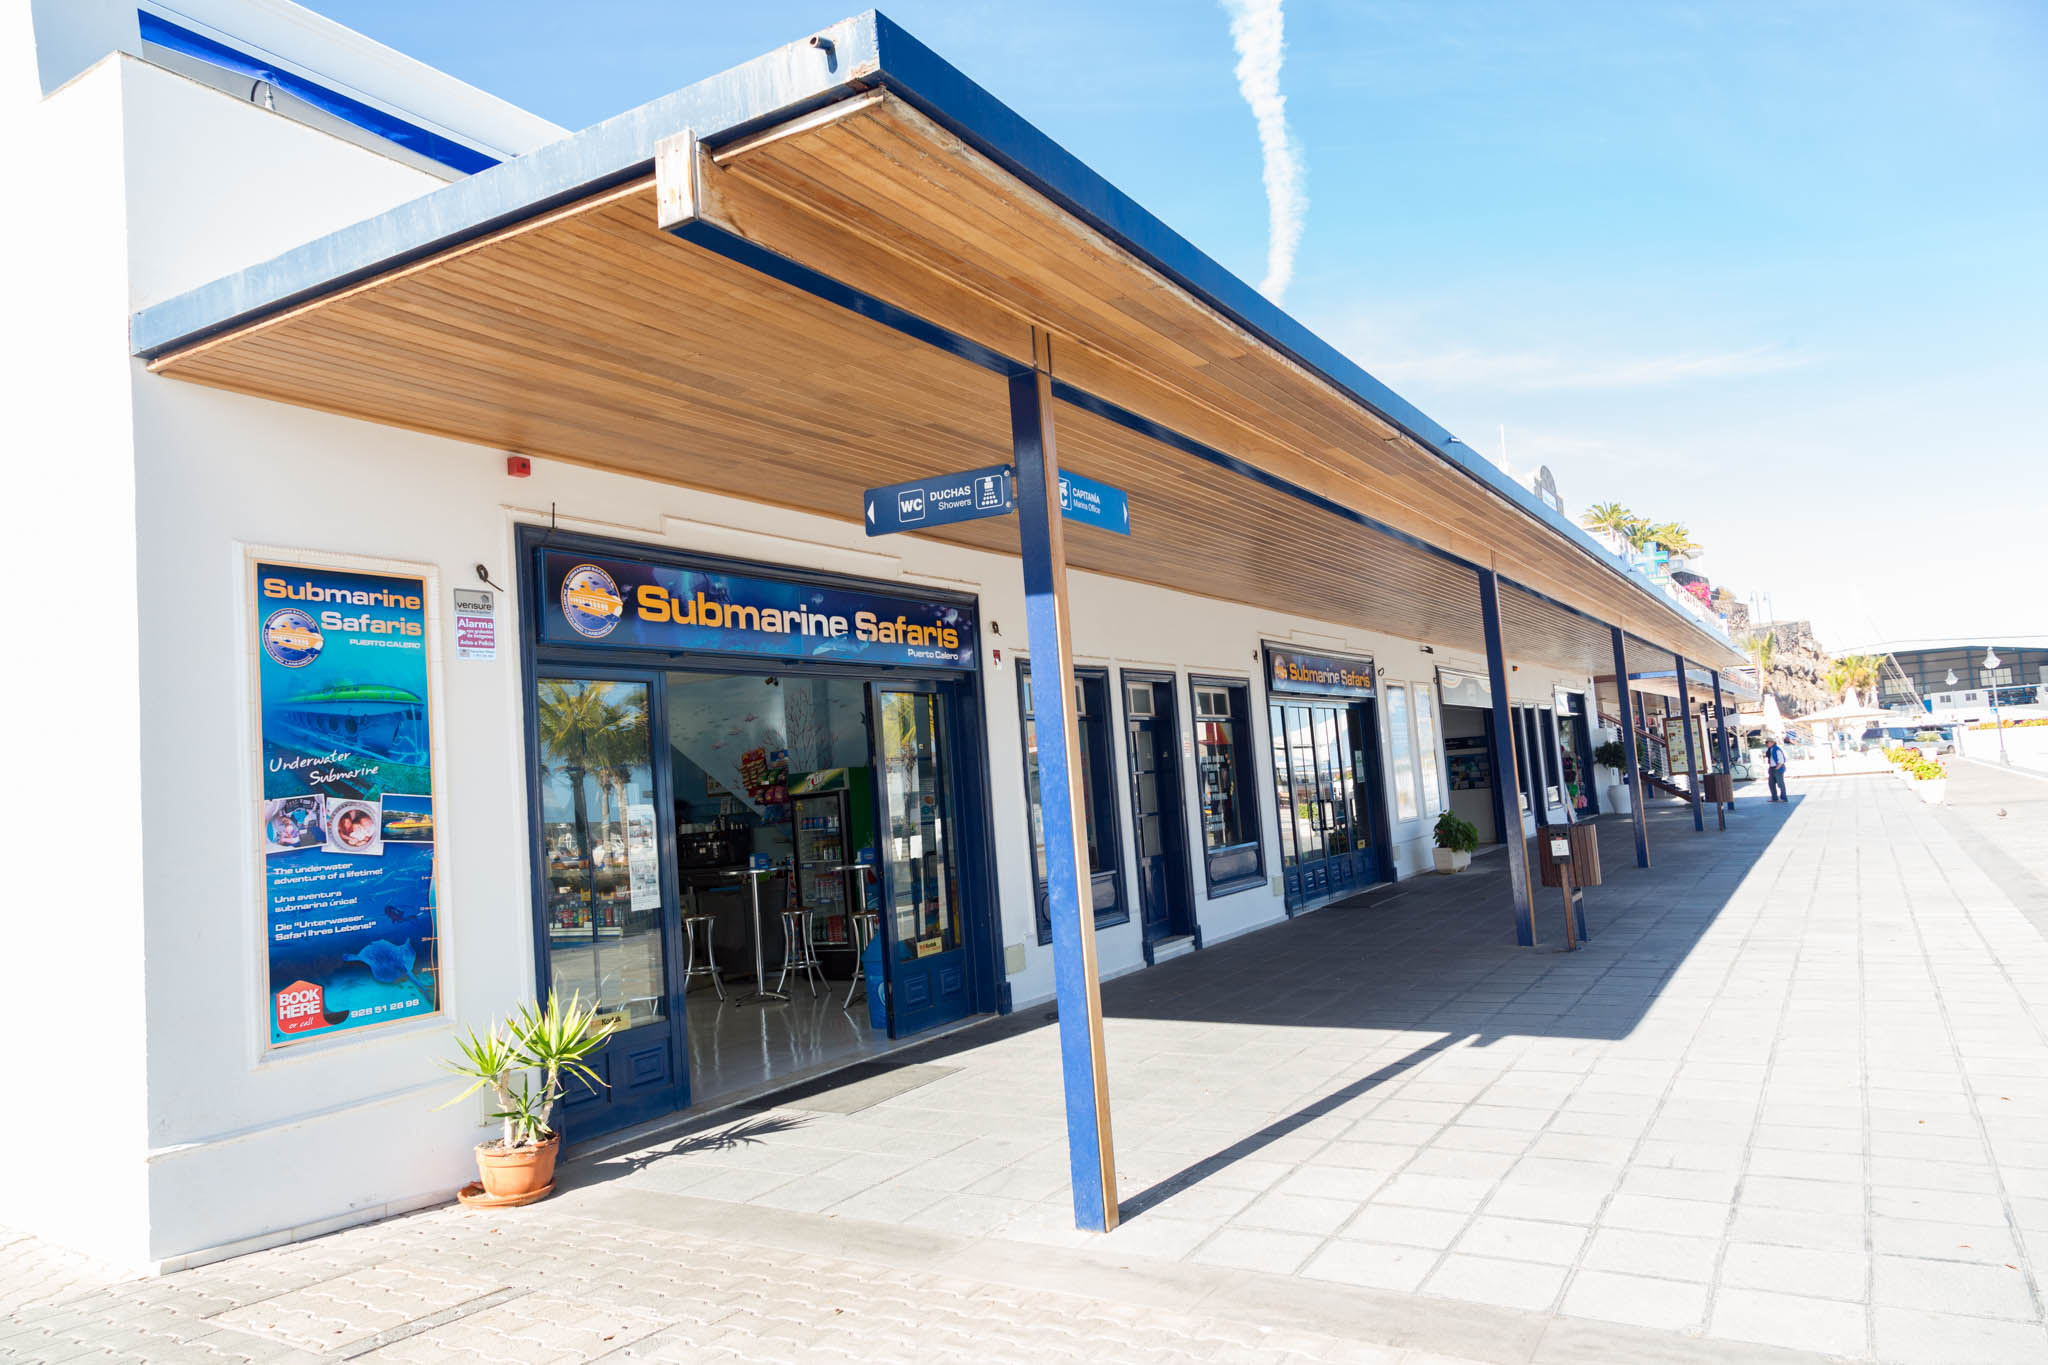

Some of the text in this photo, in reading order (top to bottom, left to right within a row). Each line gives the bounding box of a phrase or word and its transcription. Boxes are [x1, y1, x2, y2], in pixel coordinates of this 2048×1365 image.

[930, 485, 971, 501] DUCHAS
[901, 498, 923, 513] WC
[938, 499, 971, 511] Showers
[1074, 499, 1101, 514] Marina Office
[264, 578, 421, 610] Submarine
[457, 601, 492, 611] verisure
[321, 611, 422, 636] Safaris
[458, 619, 493, 629] Alarma
[637, 584, 959, 649] Submarine Safaris
[349, 638, 421, 649] PUERTO CALERO
[907, 648, 959, 660] Puerto Calero
[1289, 663, 1371, 688] Submarine Safaris
[269, 750, 351, 773] Underwater
[309, 764, 380, 785] Submarine
[273, 863, 353, 875] The underwater
[274, 874, 326, 885] adventure
[346, 868, 383, 878] lifetime!
[274, 891, 342, 903] Una aventura
[275, 897, 358, 913] submarina única!
[275, 923, 293, 932] Die
[275, 931, 307, 941] Safari
[308, 928, 333, 936] Ihres
[279, 988, 320, 1006] BOOK
[279, 1001, 321, 1020] HERE
[351, 1008, 373, 1018] 928
[374, 1005, 387, 1013] 51
[390, 1002, 404, 1010] 28
[289, 1017, 314, 1029] or call
